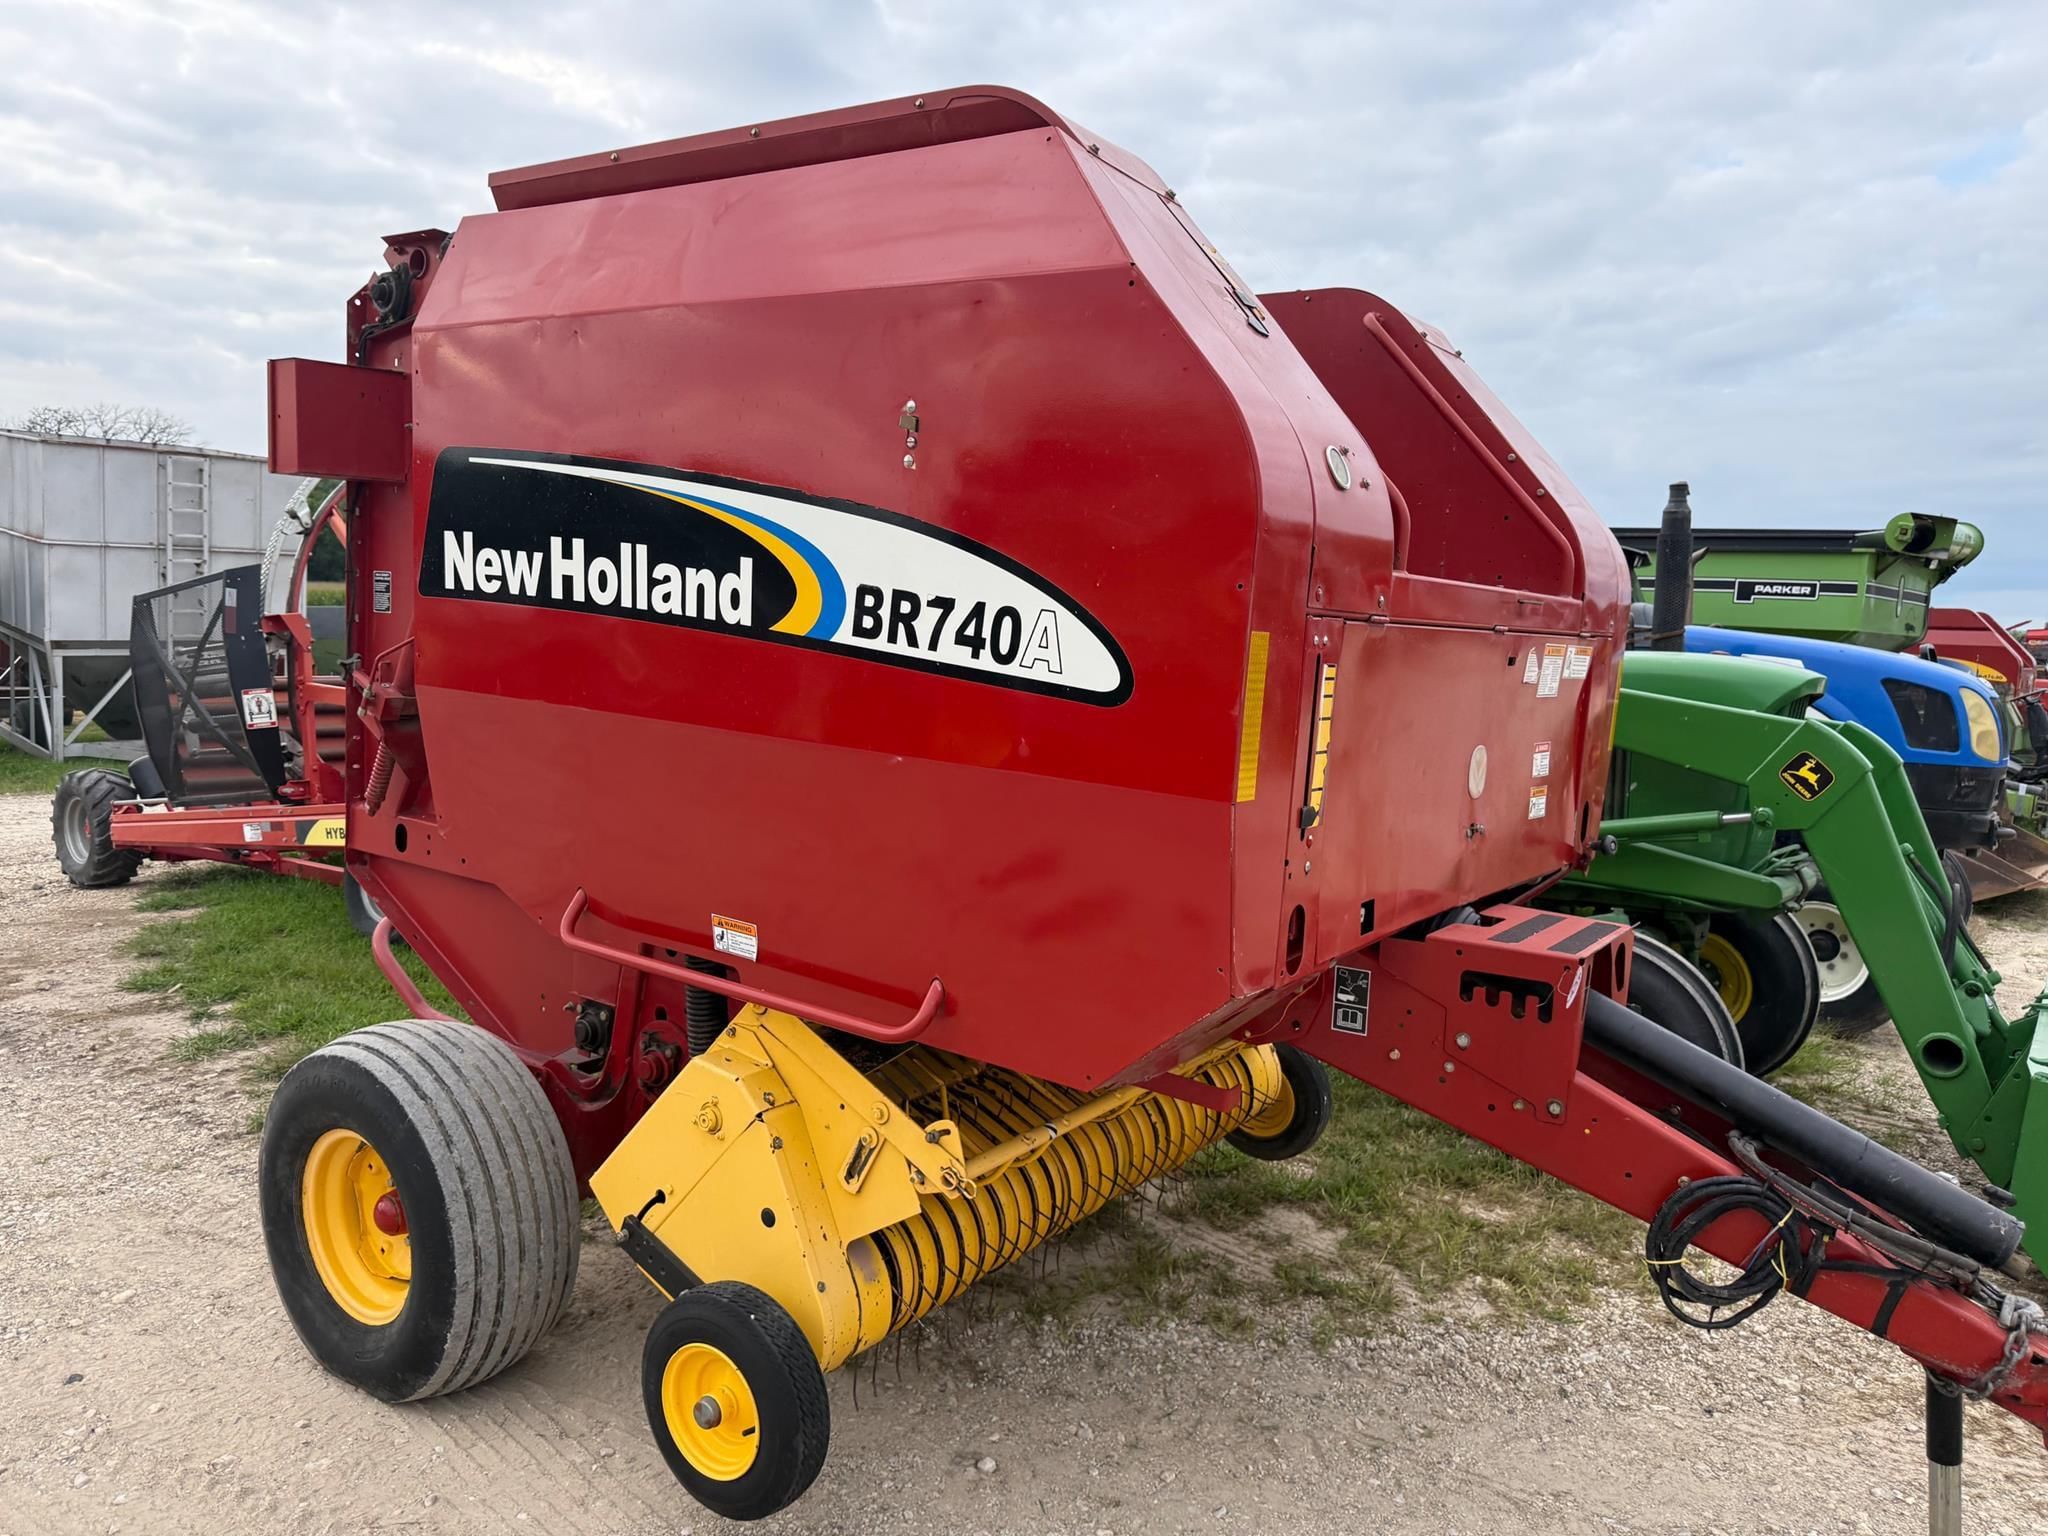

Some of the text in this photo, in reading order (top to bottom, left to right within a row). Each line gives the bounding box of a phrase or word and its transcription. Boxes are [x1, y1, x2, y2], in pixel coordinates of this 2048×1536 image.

[443, 529, 544, 597] New
[549, 535, 754, 628] Holland
[1754, 584, 1812, 595] PARKER
[851, 582, 1064, 675] BR740A
[724, 920, 753, 934] WARNING
